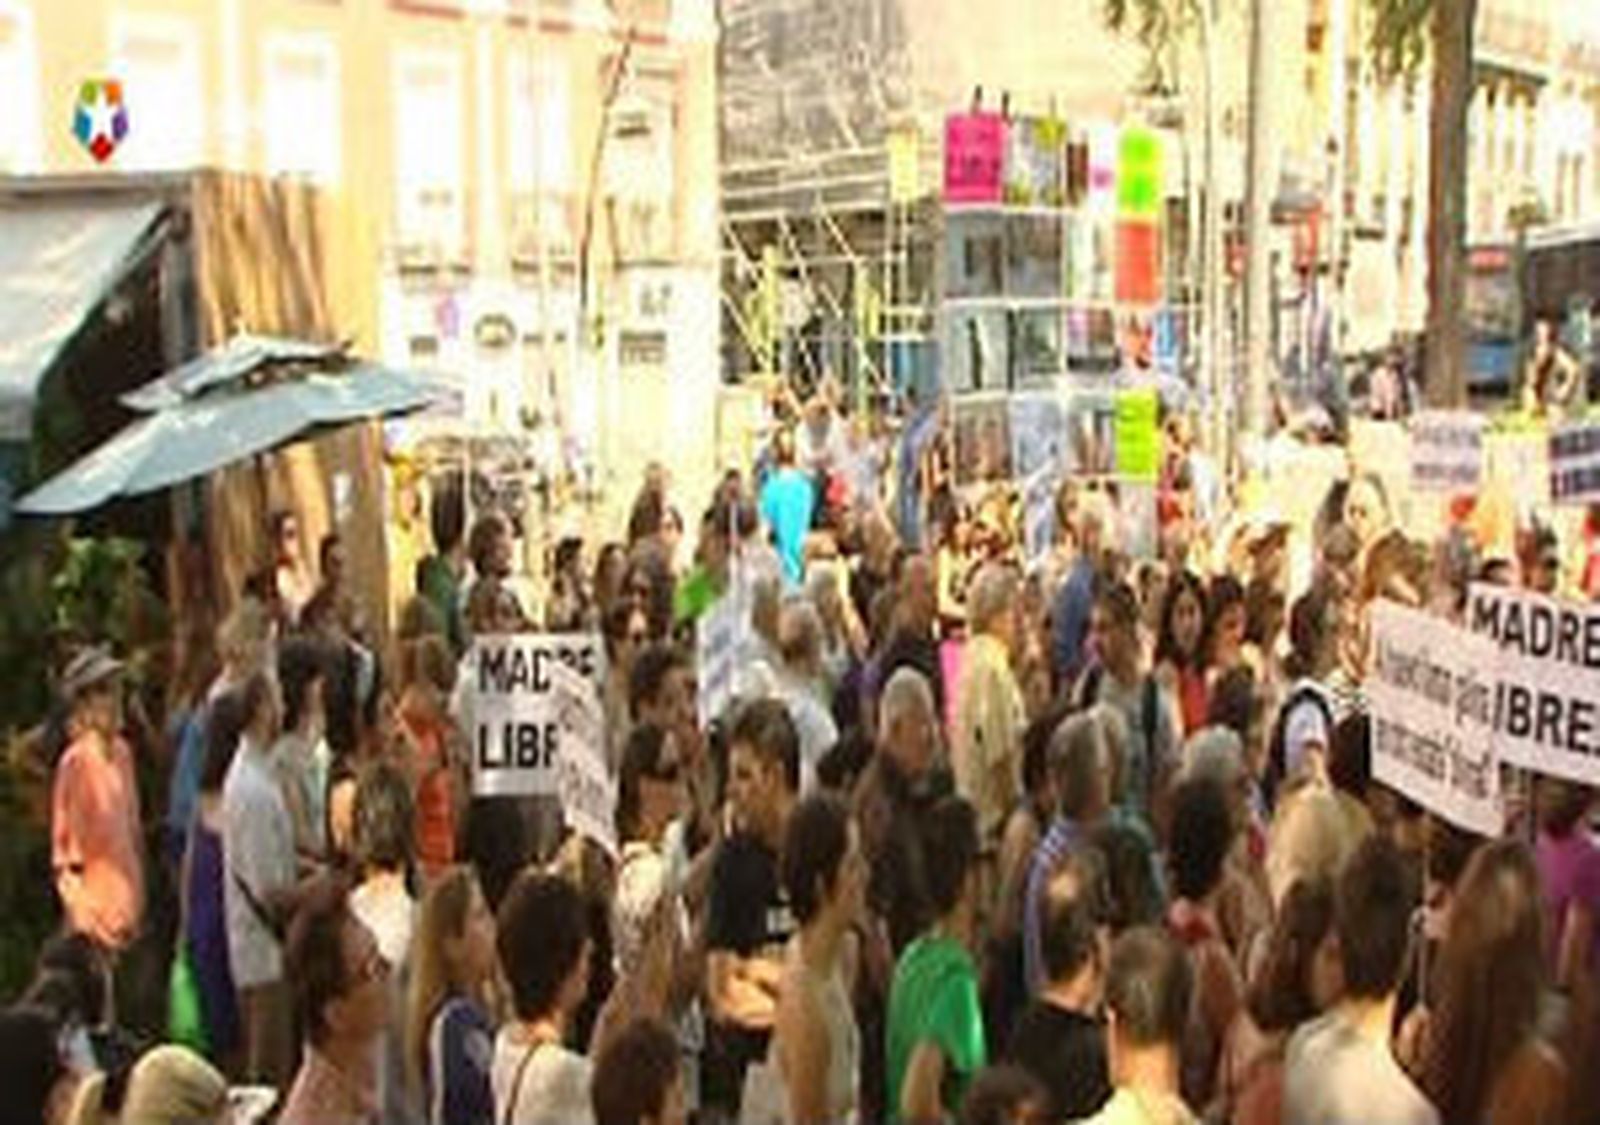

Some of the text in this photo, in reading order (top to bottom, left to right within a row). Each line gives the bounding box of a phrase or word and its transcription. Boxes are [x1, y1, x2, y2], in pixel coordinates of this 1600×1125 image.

[1471, 596, 1600, 669] MADRE
[479, 722, 559, 769] LIBR
[1492, 682, 1600, 757] IBRE
